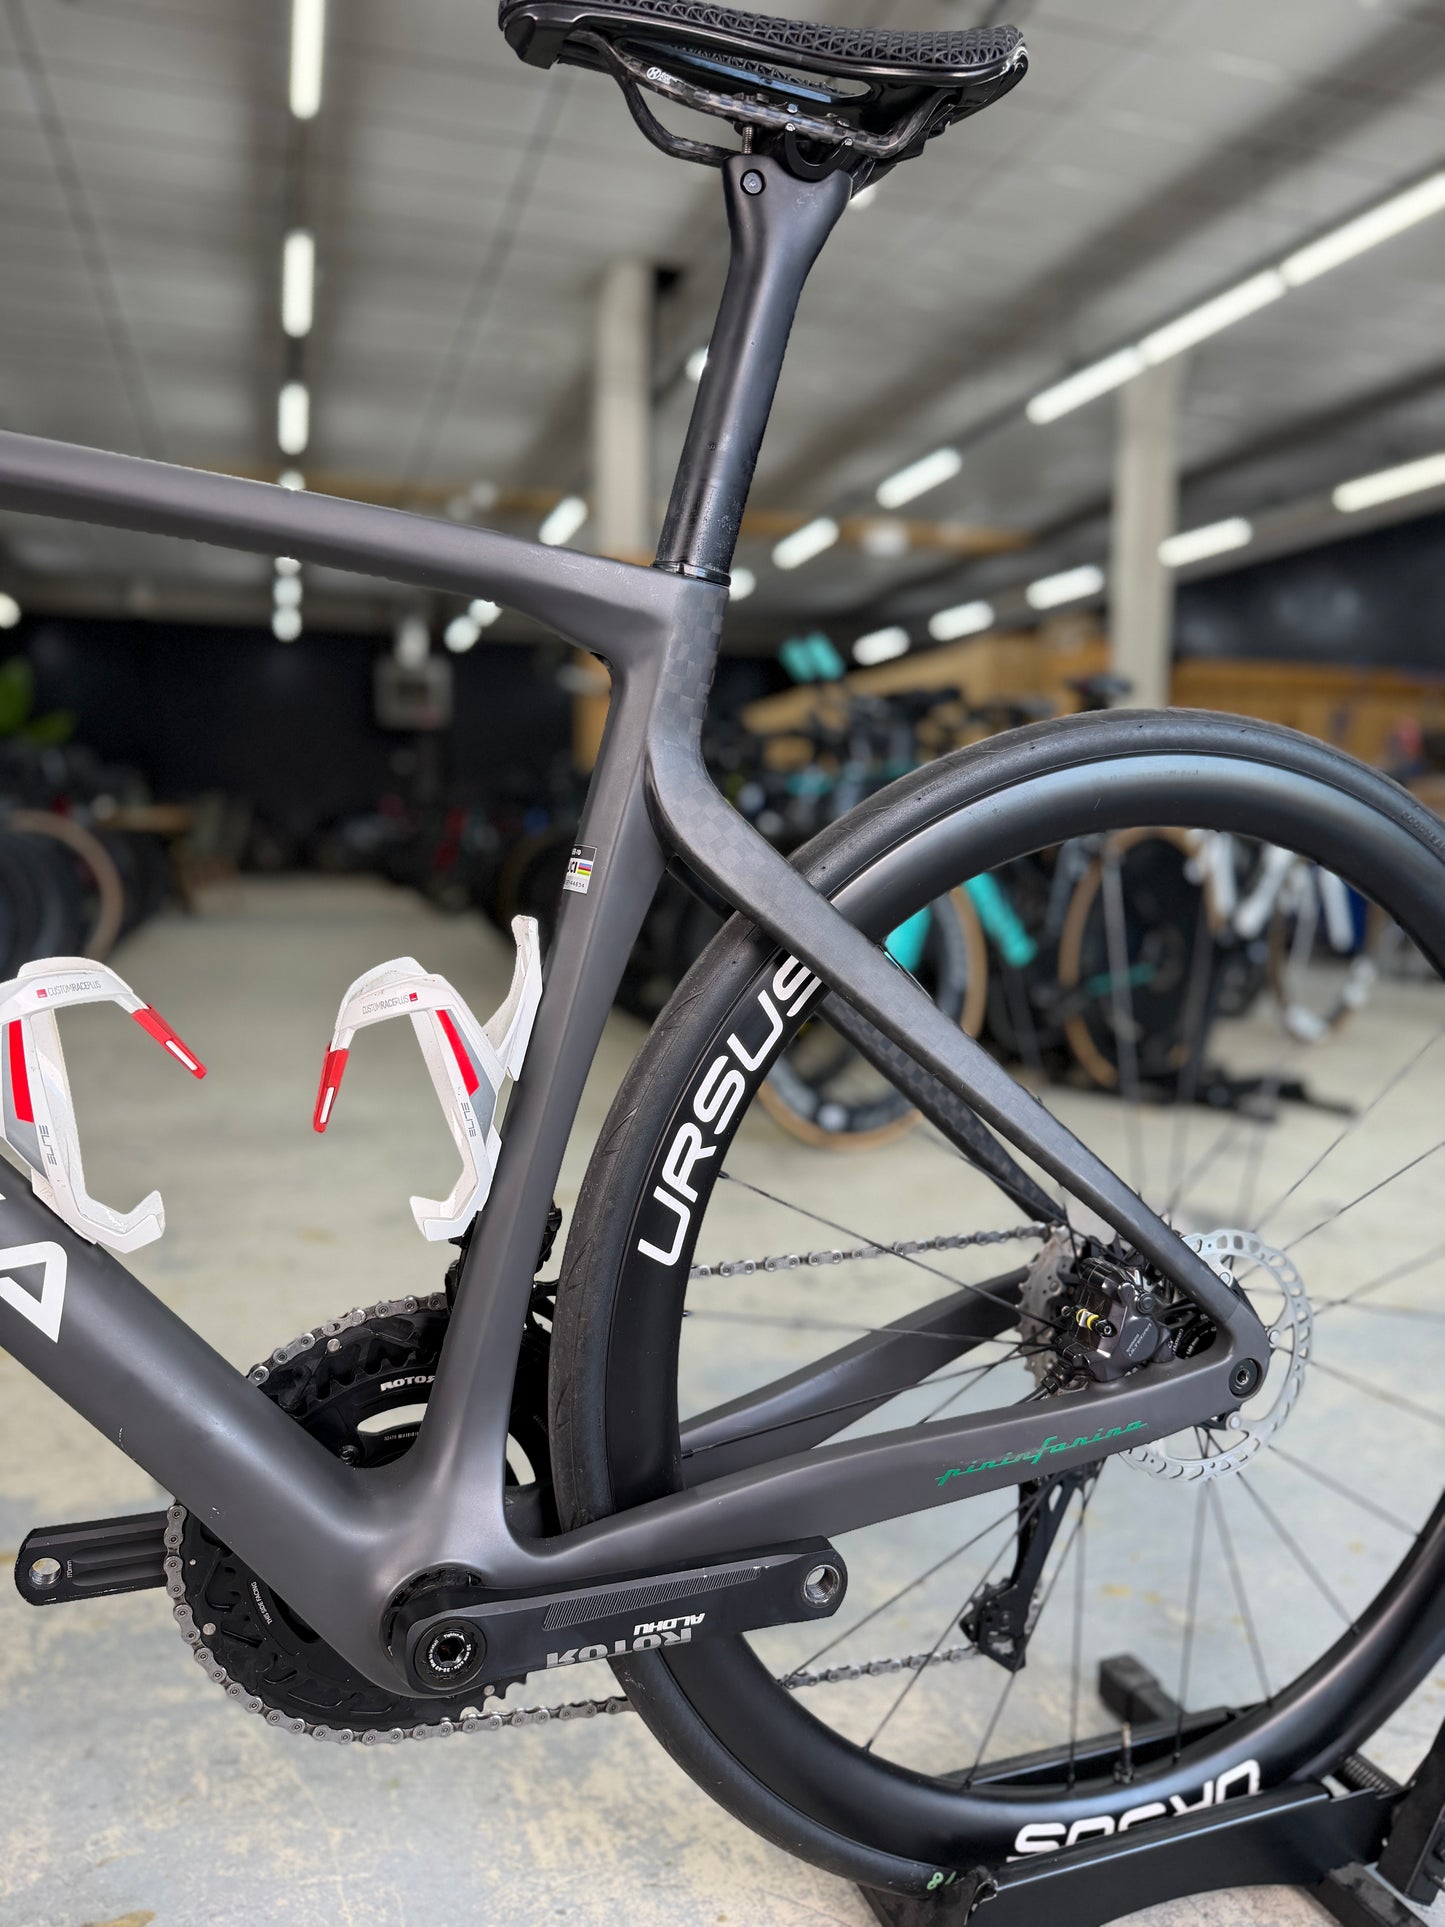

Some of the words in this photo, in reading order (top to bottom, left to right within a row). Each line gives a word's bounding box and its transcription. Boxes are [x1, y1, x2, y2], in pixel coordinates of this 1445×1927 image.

[47, 981, 102, 997] CUSTOMRACEPLUS
[361, 994, 410, 1015] CUSTOMRACEPLUS
[460, 1102, 477, 1138] ELITE
[637, 954, 822, 1267] URSUS
[38, 1124, 58, 1166] ELITE
[633, 1612, 706, 1636] ALDHU
